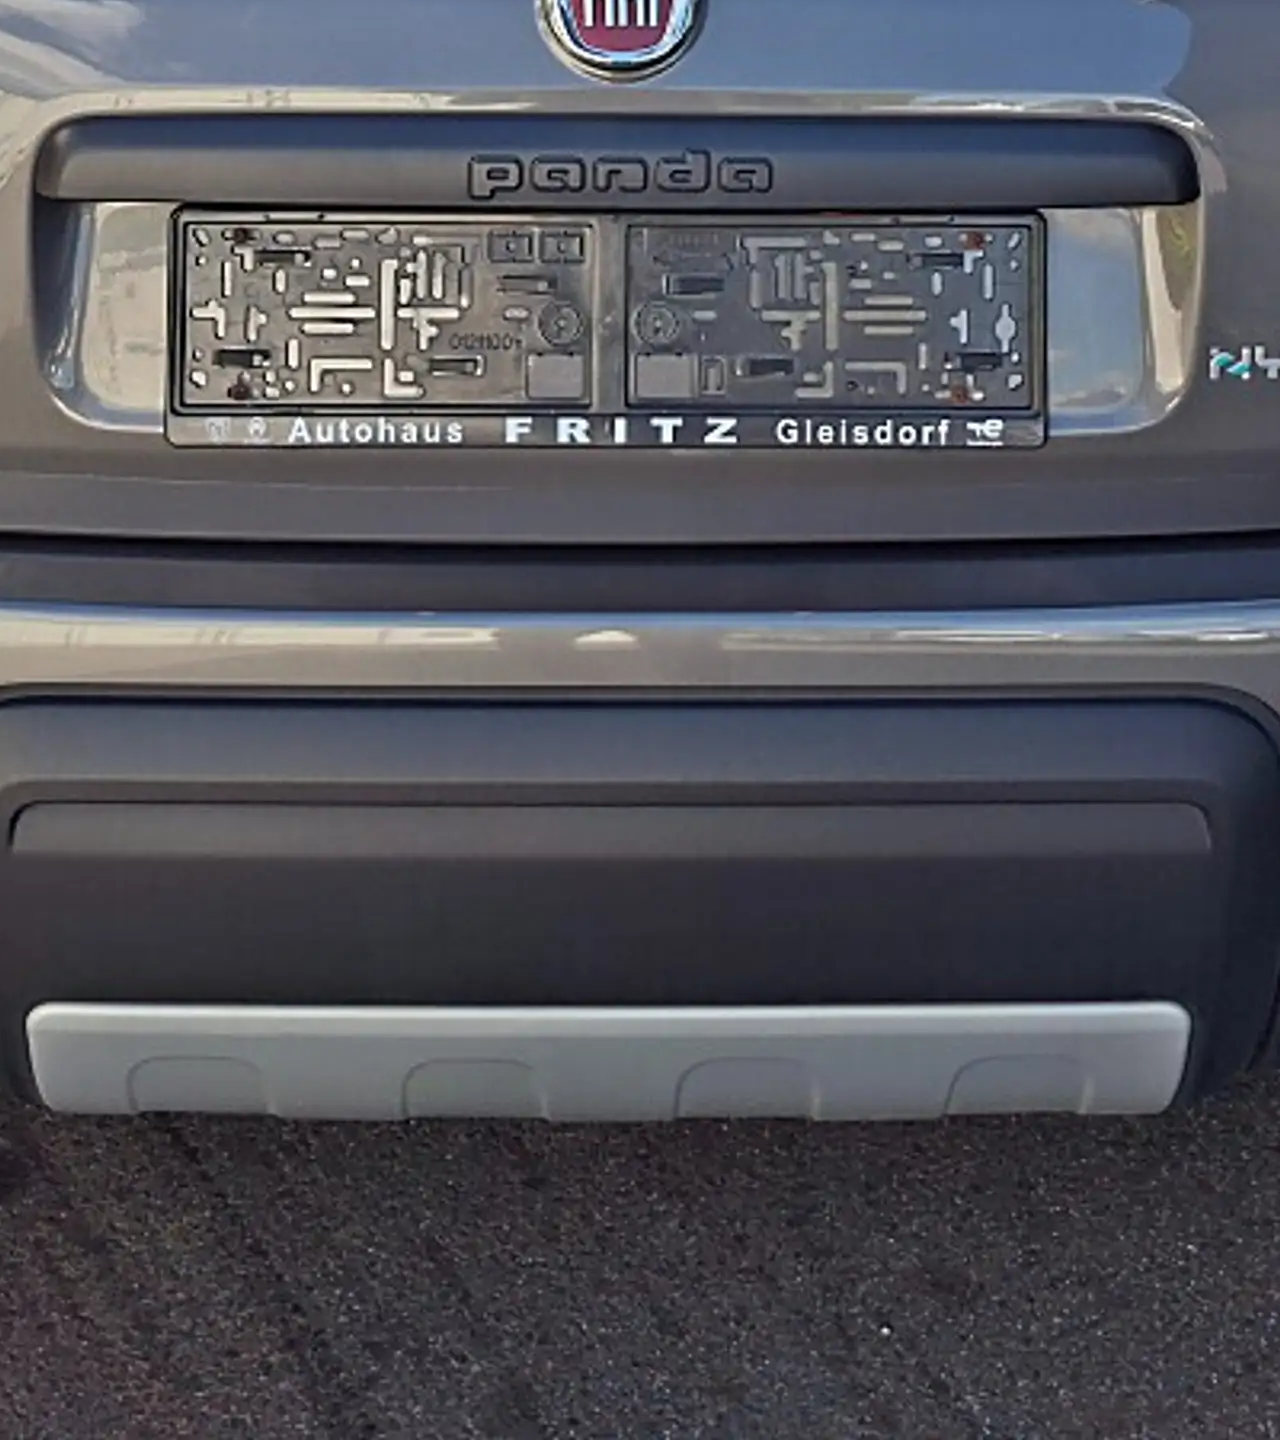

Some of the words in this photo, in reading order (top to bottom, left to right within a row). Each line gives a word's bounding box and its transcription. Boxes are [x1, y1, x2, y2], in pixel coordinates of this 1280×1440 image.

[467, 148, 775, 200] panda
[287, 416, 465, 444] Autohaus
[504, 417, 739, 444] FRITZ
[775, 417, 951, 446] Gleisdorf
